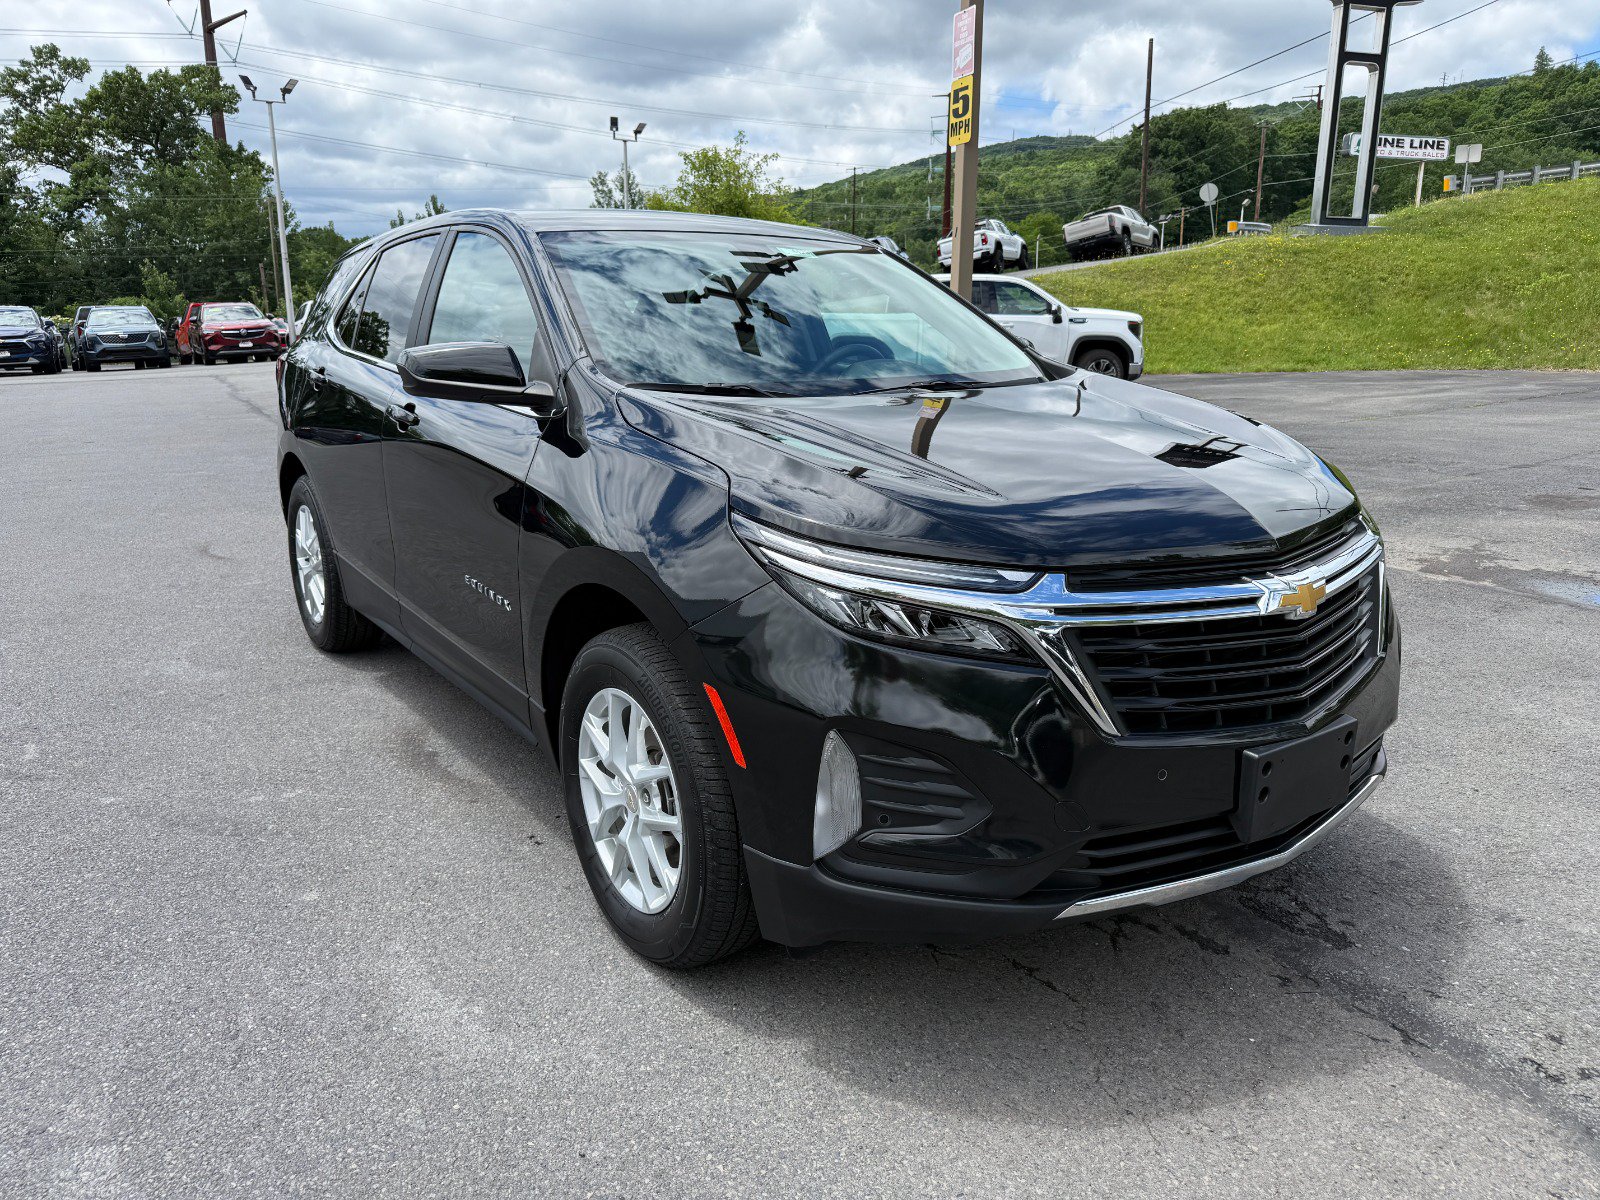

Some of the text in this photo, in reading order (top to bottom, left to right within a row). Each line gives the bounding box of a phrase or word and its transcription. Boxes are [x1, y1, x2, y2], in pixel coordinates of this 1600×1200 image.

[952, 85, 969, 119] 5
[950, 118, 970, 137] MPH
[1378, 137, 1445, 150] INE LINE
[464, 574, 512, 611] EQUINOX
